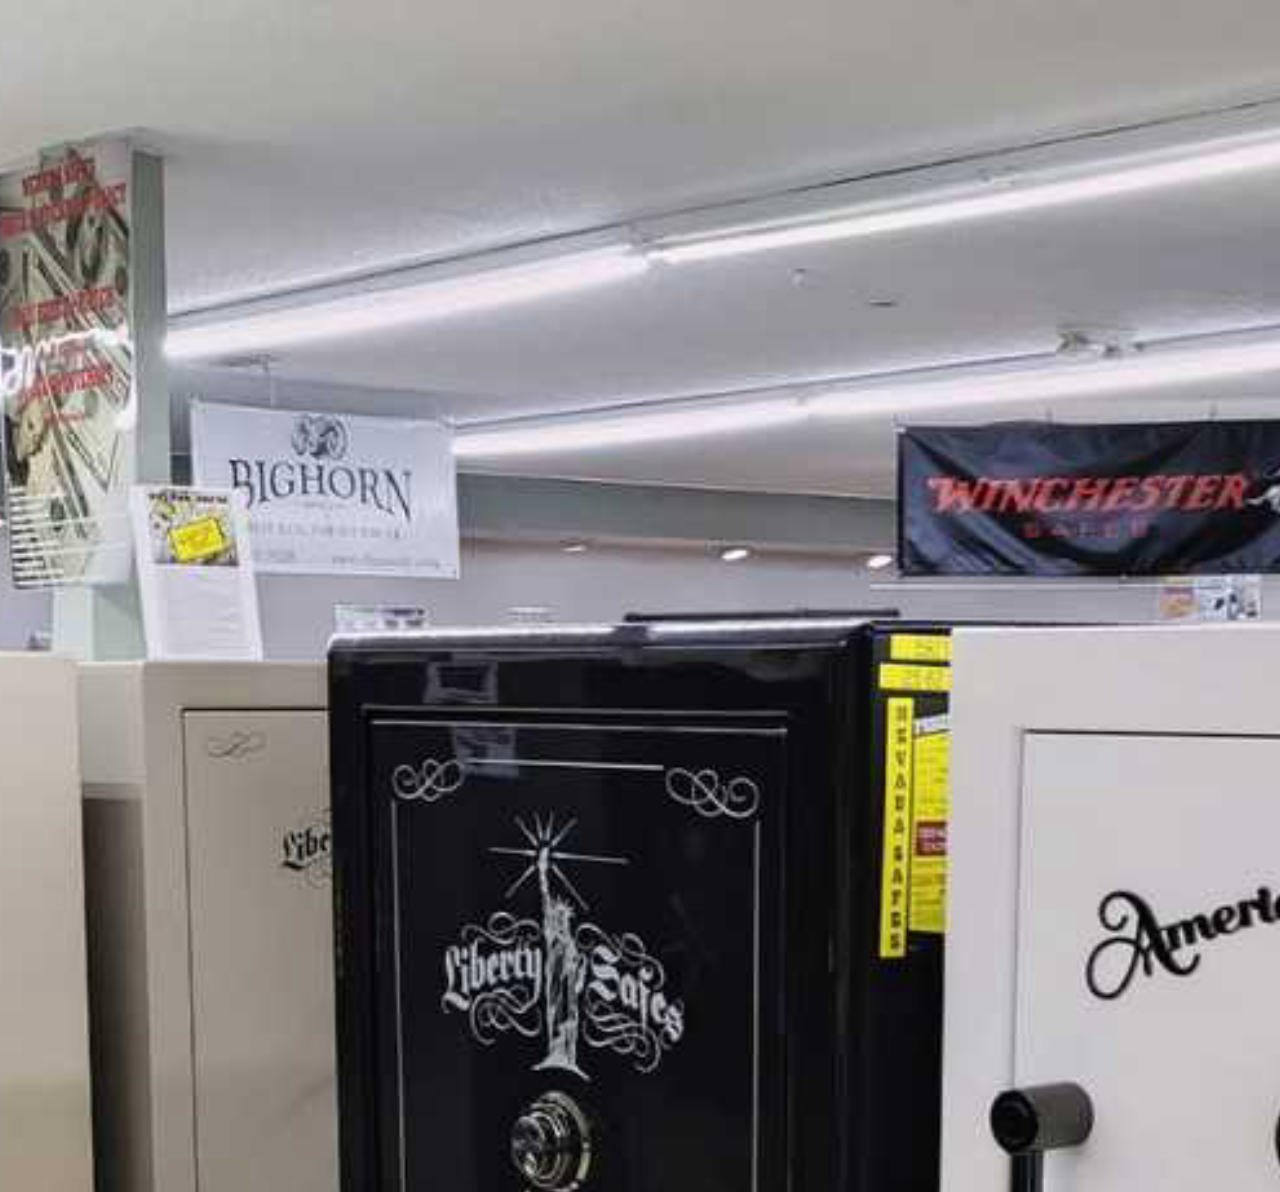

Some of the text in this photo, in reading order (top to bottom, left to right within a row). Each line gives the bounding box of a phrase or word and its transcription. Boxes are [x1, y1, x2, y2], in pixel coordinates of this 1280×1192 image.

[228, 458, 413, 523] BIGHORN
[927, 471, 1251, 514] WINCHESTER
[441, 937, 685, 1044] Liberty Safes
